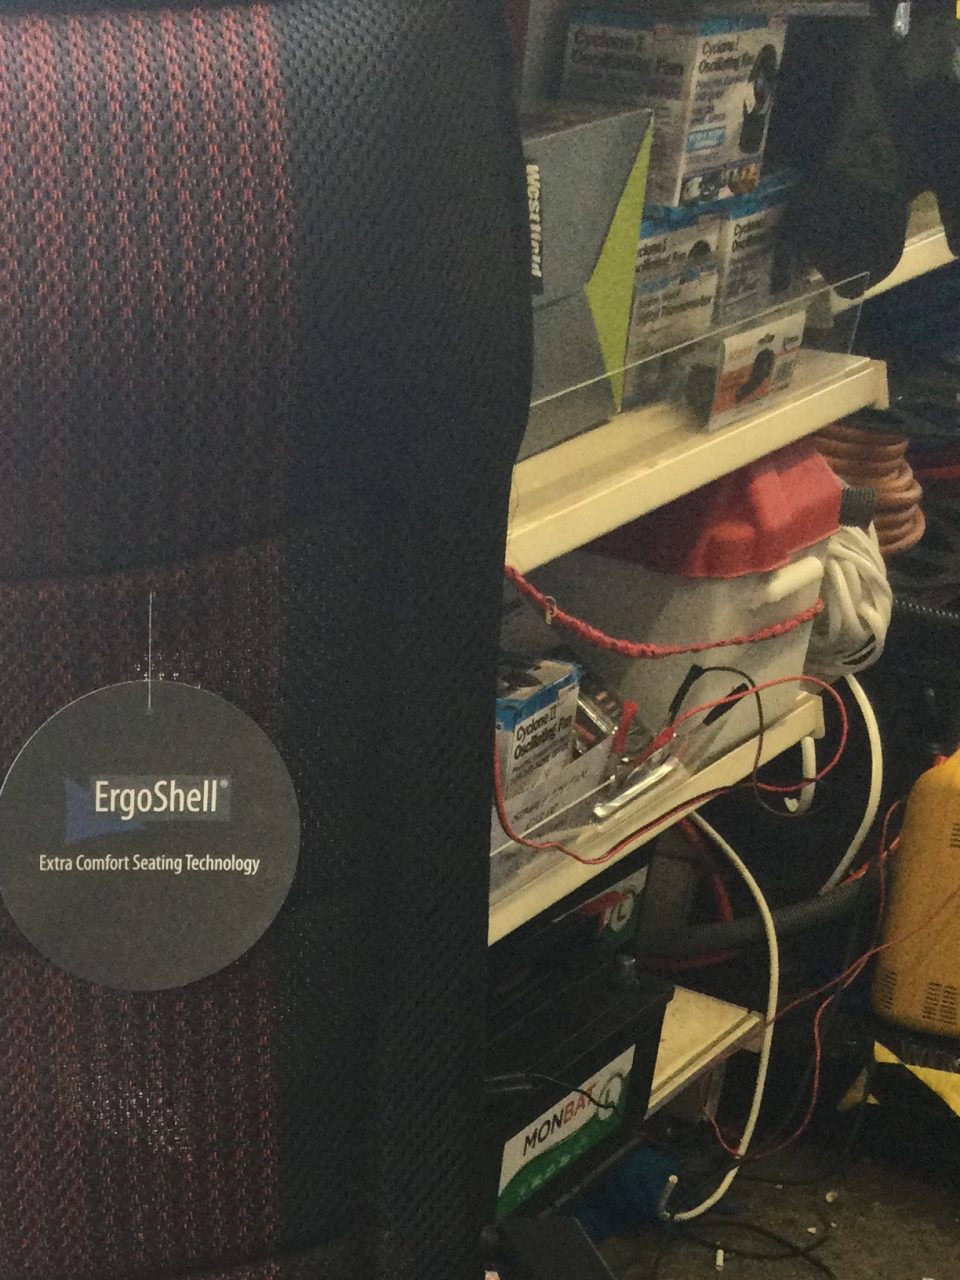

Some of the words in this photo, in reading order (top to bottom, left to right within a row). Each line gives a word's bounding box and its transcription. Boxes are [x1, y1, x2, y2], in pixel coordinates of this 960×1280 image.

[39, 855, 73, 872] Extra
[75, 854, 130, 871] Comfort
[132, 855, 183, 875] Seating
[185, 854, 261, 876] Technology
[522, 1082, 597, 1157] MONBAT
